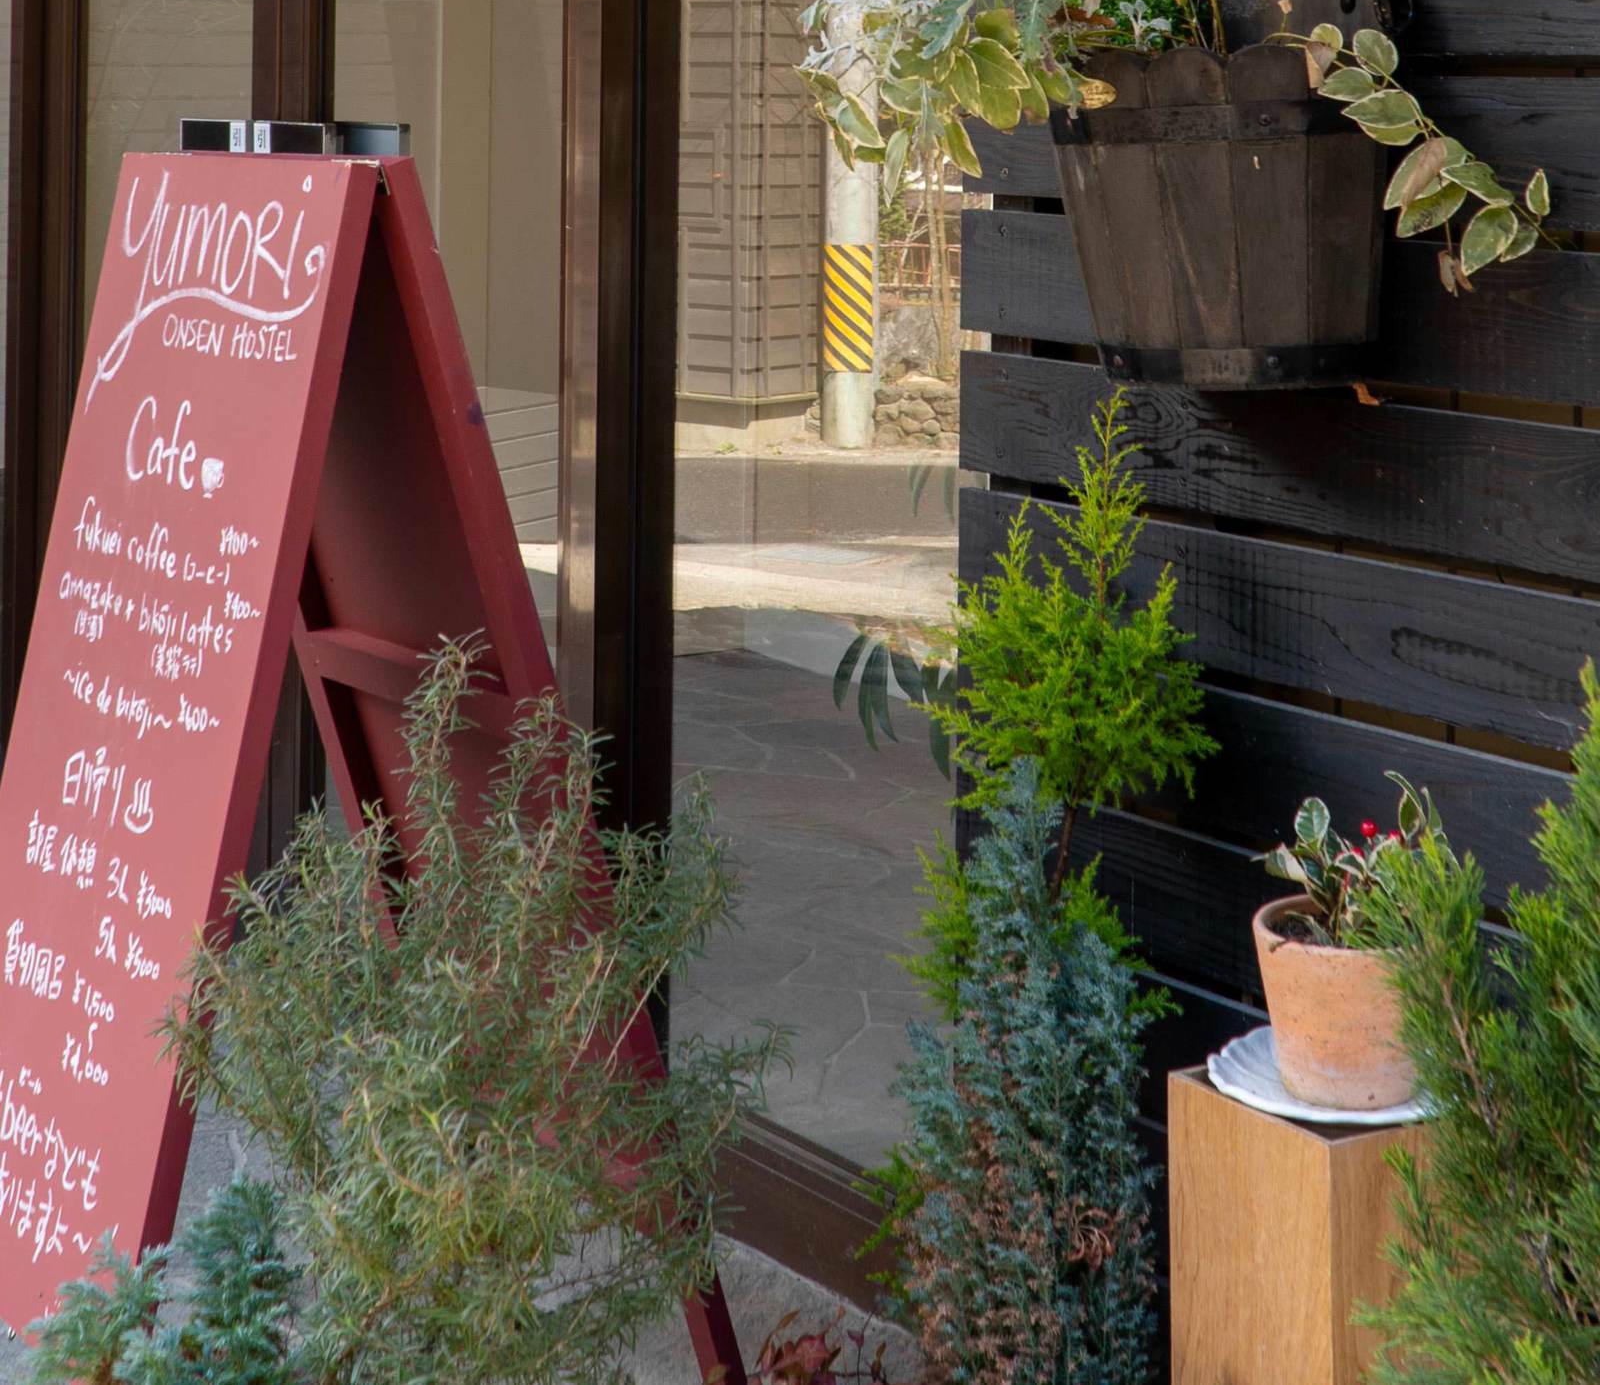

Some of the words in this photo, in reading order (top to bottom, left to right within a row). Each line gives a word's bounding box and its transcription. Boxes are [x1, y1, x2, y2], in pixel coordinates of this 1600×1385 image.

[161, 313, 225, 357] ONSEN
[230, 321, 298, 363] HOSTEL
[126, 395, 197, 490] Cafe
[127, 521, 177, 579] coffee
[179, 605, 234, 654] lattes
